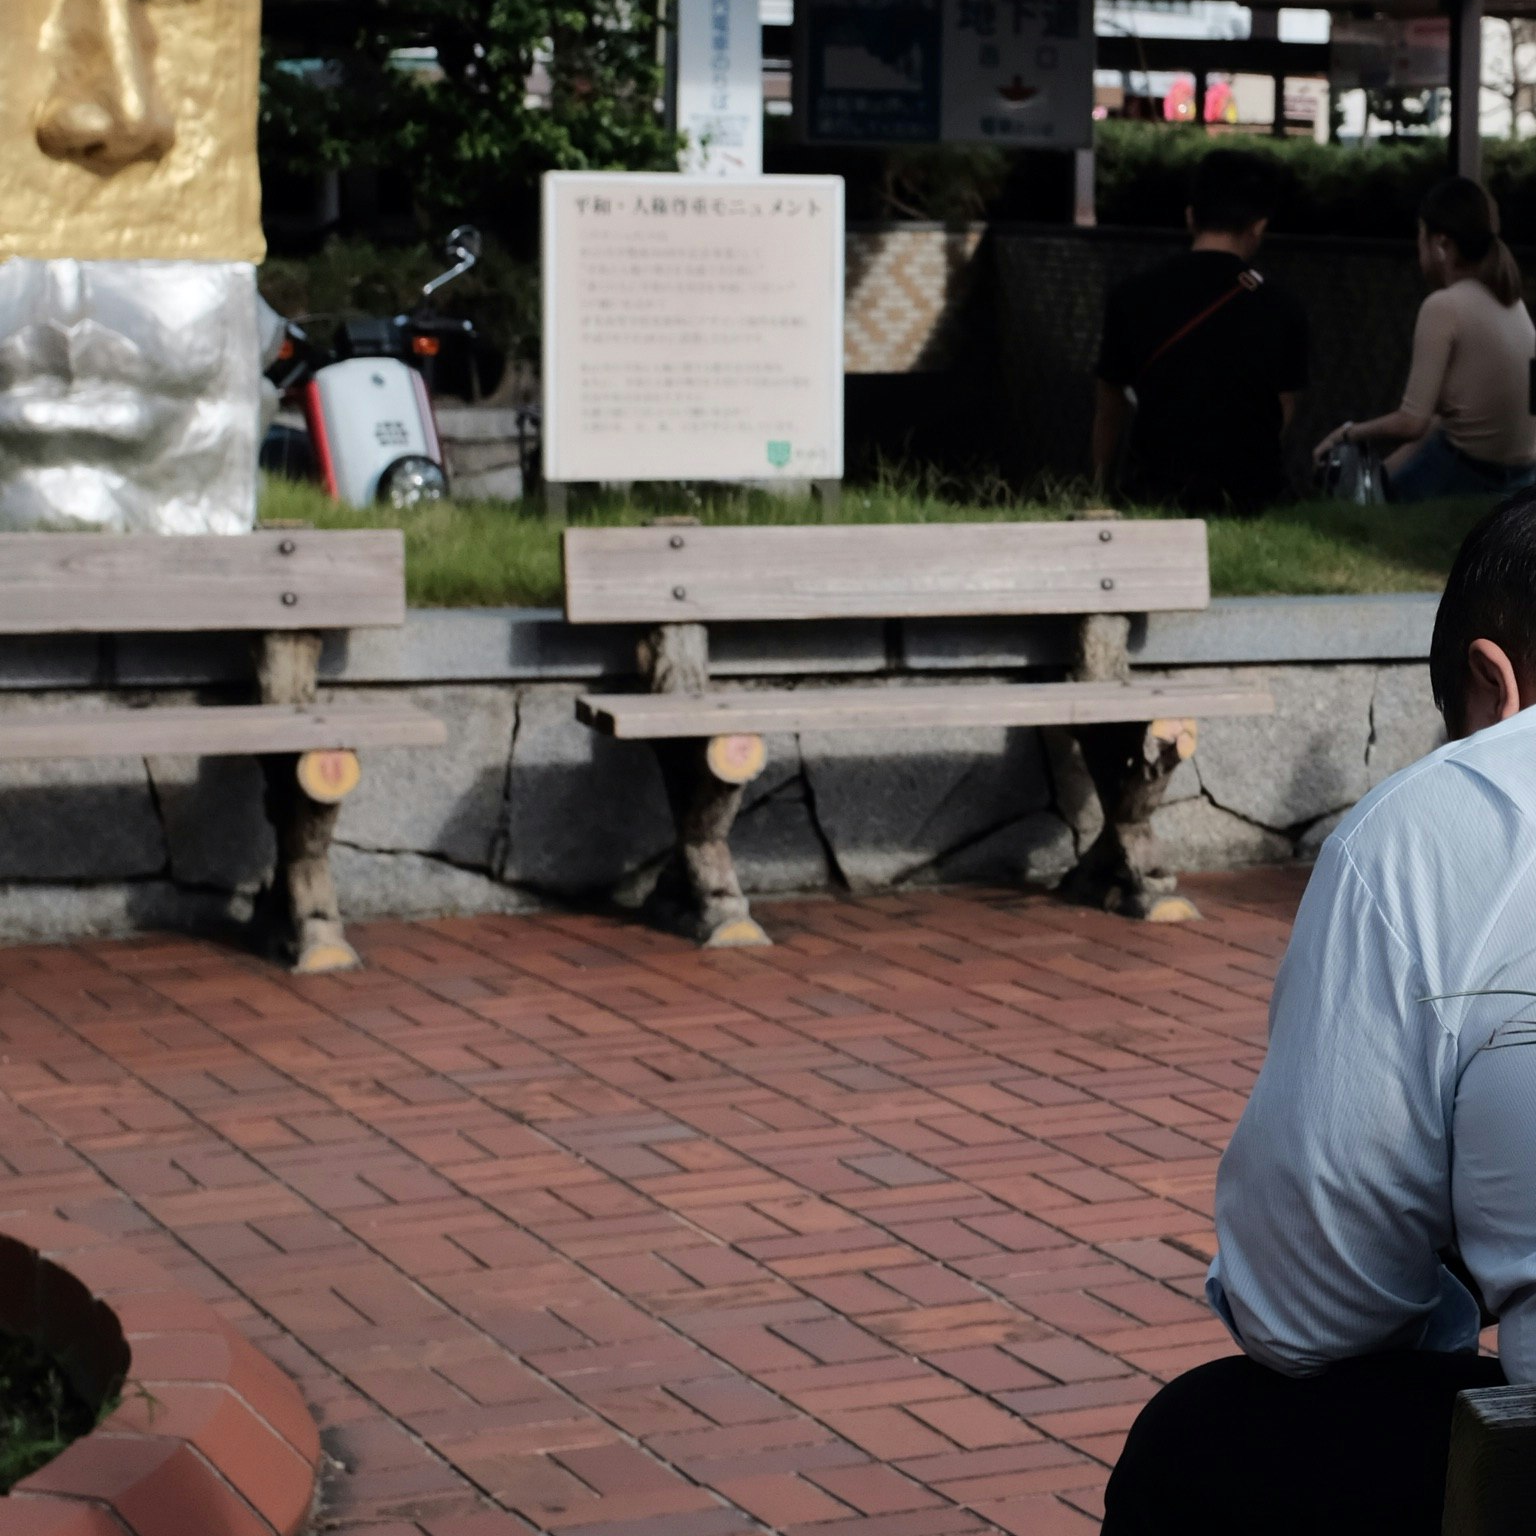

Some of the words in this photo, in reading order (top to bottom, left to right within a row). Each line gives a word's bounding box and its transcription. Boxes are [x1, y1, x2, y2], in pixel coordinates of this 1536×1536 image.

[575, 195, 821, 218] 平和・人権尊重モニュメント
